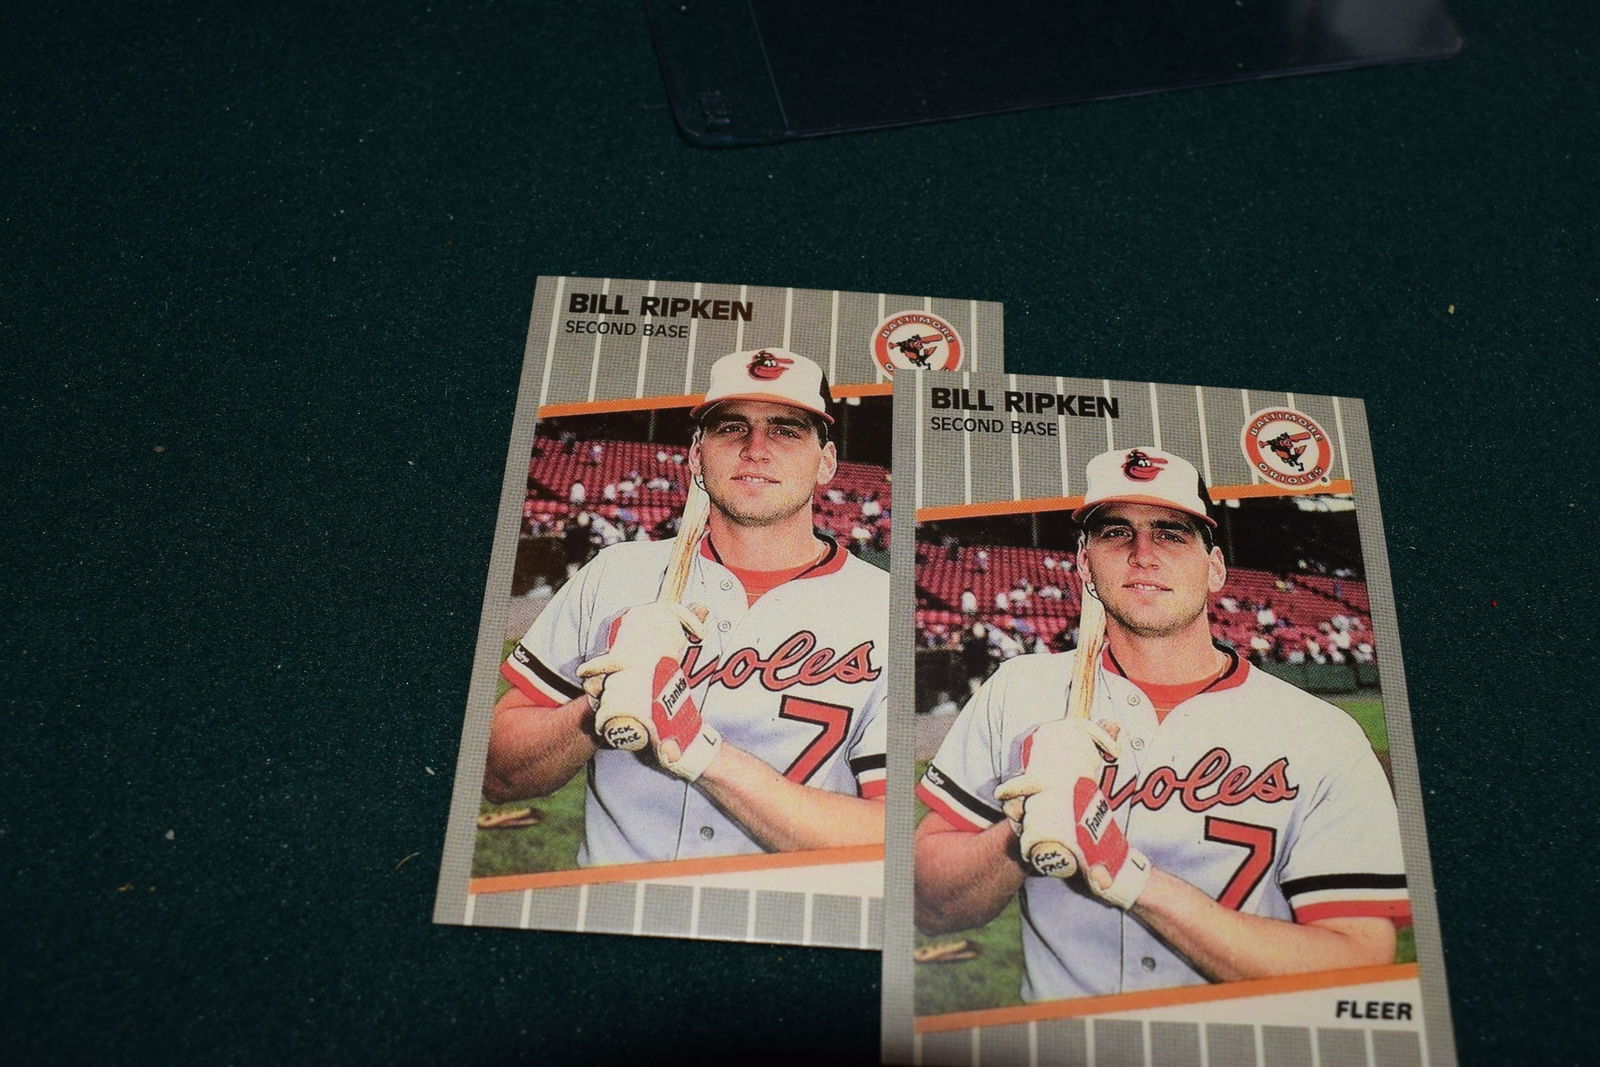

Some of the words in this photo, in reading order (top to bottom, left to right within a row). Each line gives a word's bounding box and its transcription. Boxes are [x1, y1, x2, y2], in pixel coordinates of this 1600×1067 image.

[568, 293, 629, 315] BILL
[640, 296, 753, 322] RIPKEN
[565, 320, 636, 336] SECOND
[643, 324, 688, 338] BASE
[881, 315, 955, 343] BALTIMORE
[931, 387, 994, 412] BILL
[1004, 391, 1119, 419] RIPKEN
[931, 417, 1004, 433] SECOND
[1011, 421, 1057, 436] BASE
[1250, 413, 1324, 441] BALTIMORE
[1258, 461, 1323, 486] ORIOLES
[779, 694, 854, 785] 7
[1204, 815, 1277, 911] 7
[1336, 1000, 1412, 1020] FLEER
